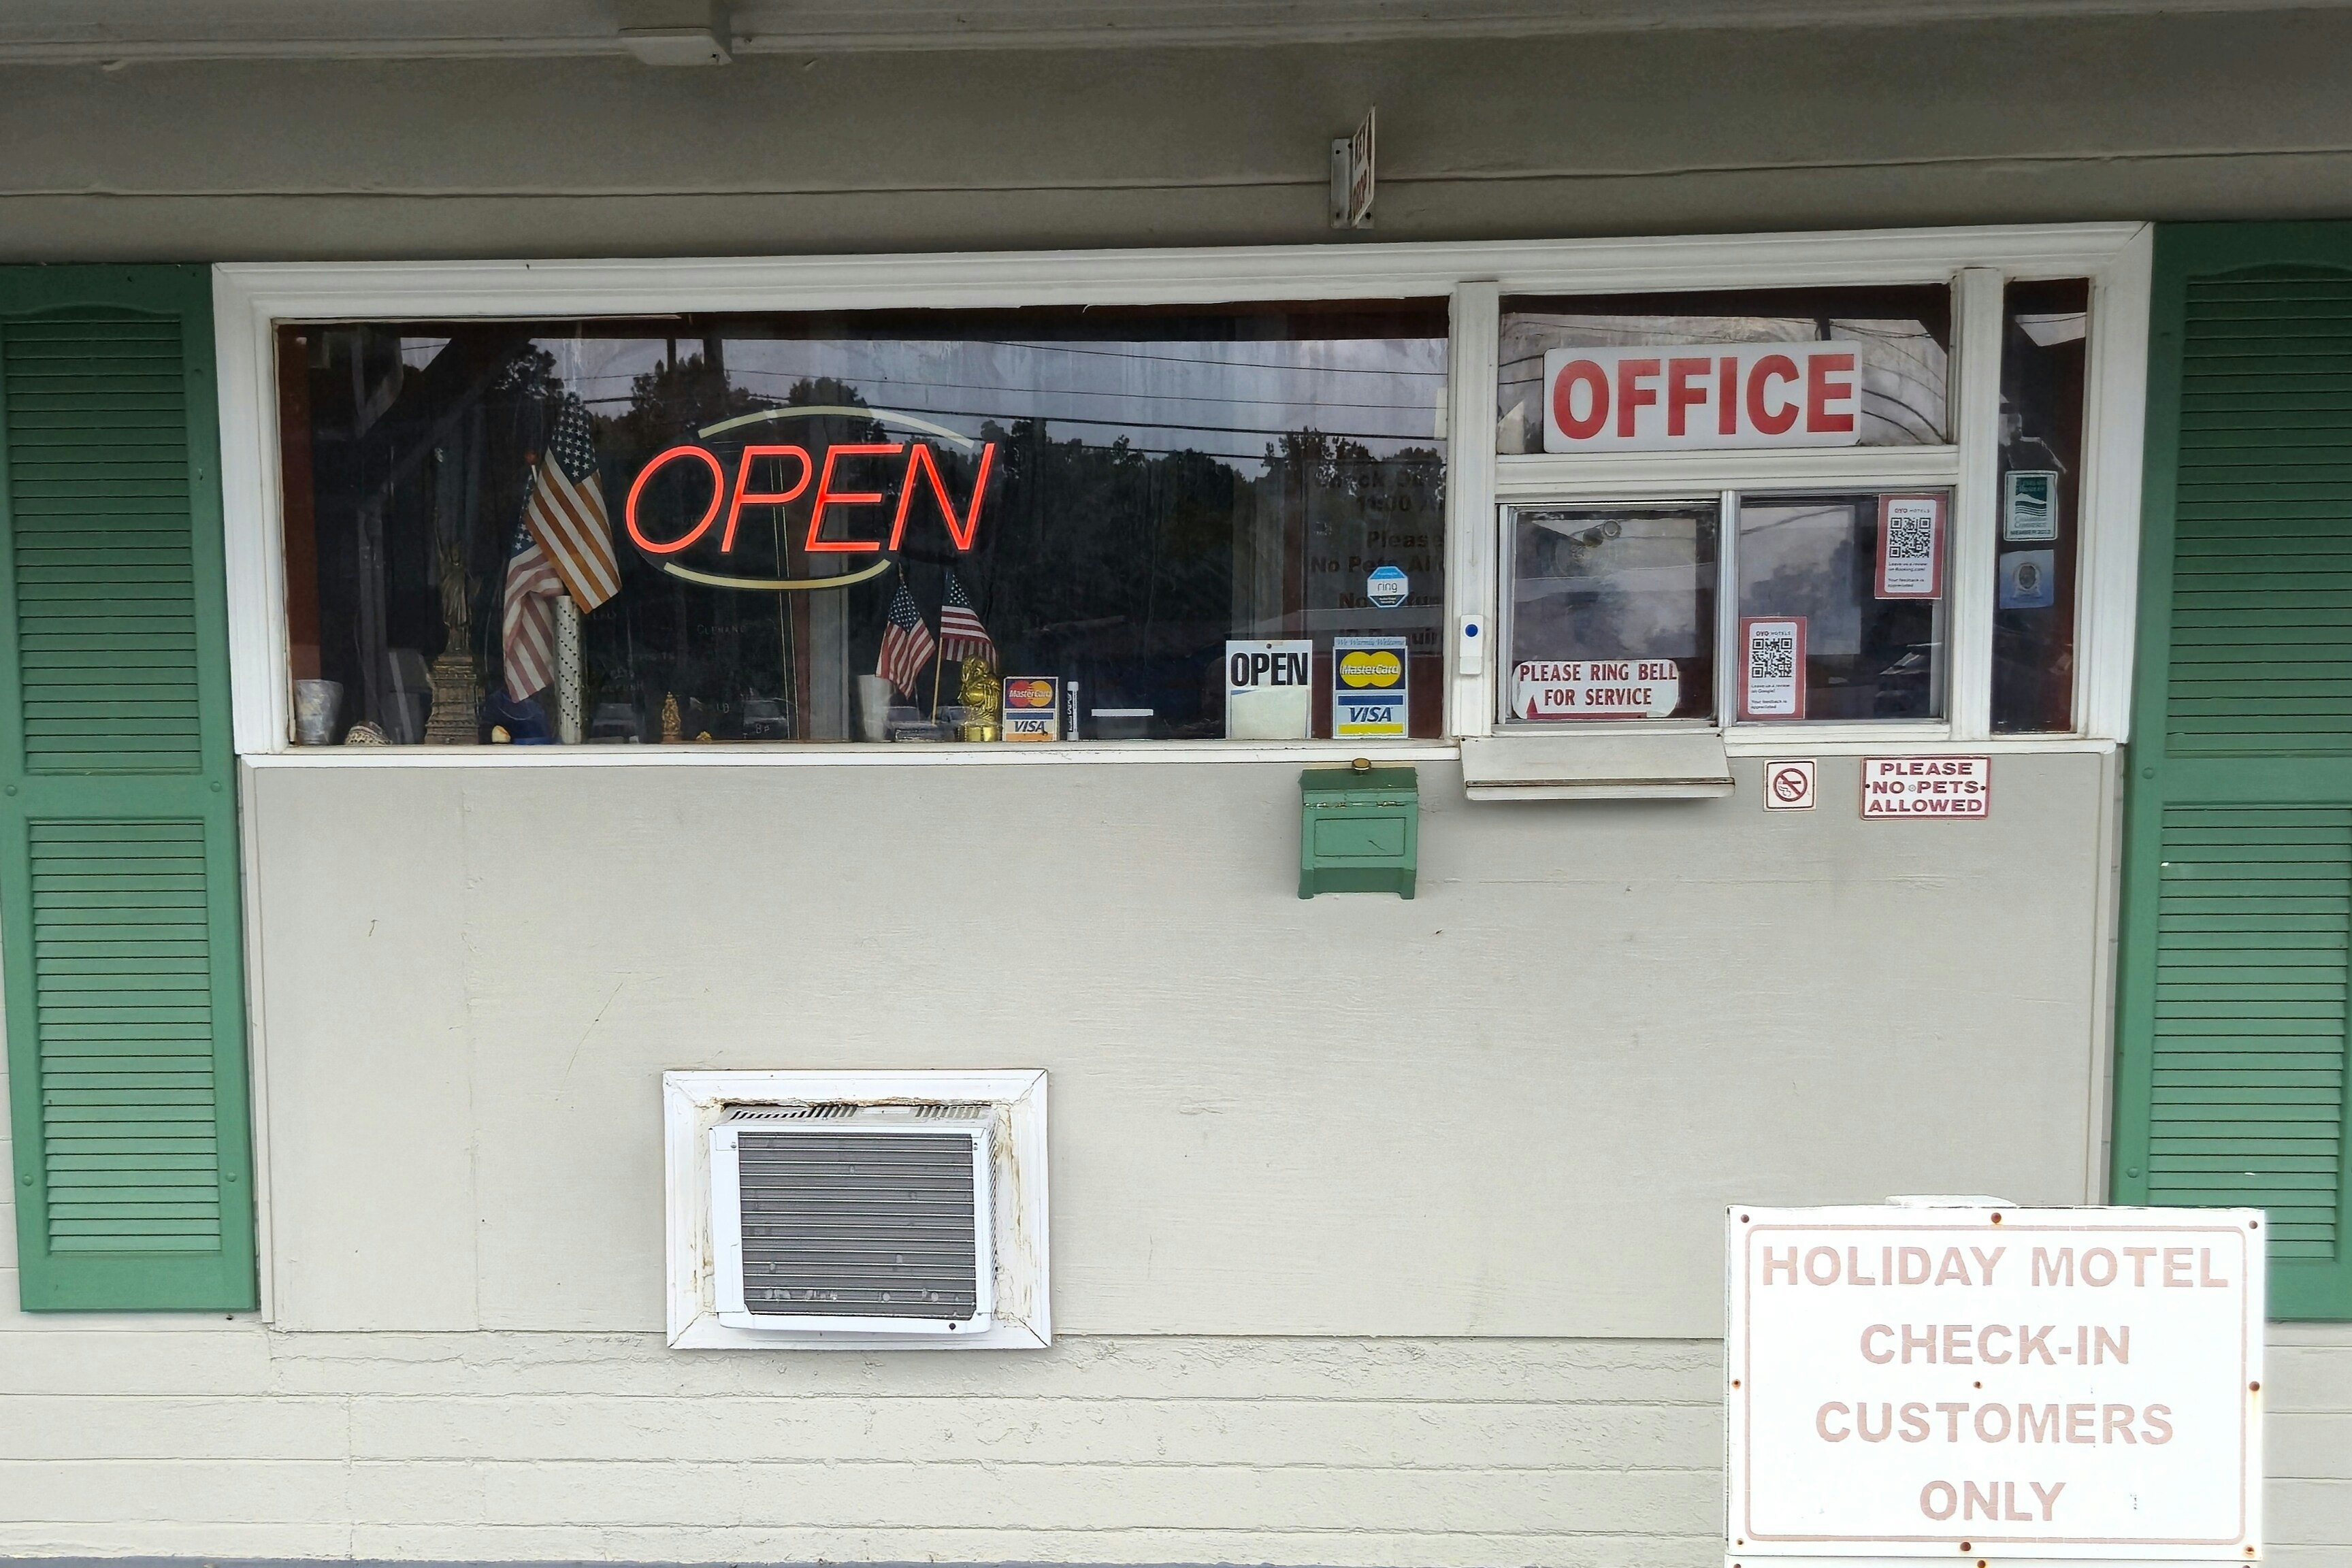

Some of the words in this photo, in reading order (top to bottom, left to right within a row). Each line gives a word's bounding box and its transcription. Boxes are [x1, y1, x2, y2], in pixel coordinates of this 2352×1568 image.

[1554, 353, 1855, 439] OFFICE
[625, 442, 994, 553] OPEN
[1311, 555, 1340, 572] No
[1377, 582, 1397, 593] ring
[1230, 652, 1308, 687] OPEN
[1341, 664, 1399, 676] MasterCard
[1520, 664, 1581, 681] PLEASE
[1590, 664, 1629, 681] RING
[1638, 663, 1678, 681] BELL
[1009, 689, 1051, 698] MasterCard
[1544, 689, 1575, 706] FOR
[1585, 688, 1652, 706] SERVICE
[1348, 706, 1392, 722] VISA
[1014, 721, 1045, 733] VISA
[1880, 762, 1973, 776] PLEASE
[1872, 781, 1905, 794] NO
[1916, 781, 1979, 794] PETS
[1867, 799, 1982, 813] ALLOWED
[1762, 1245, 2007, 1286] HOLIDAY
[2031, 1247, 2230, 1288] MOTEL
[1860, 1324, 2130, 1365] CHECK-IN
[1816, 1401, 2174, 1445] CUSTOMERS
[1919, 1480, 2066, 1521] ONLY
